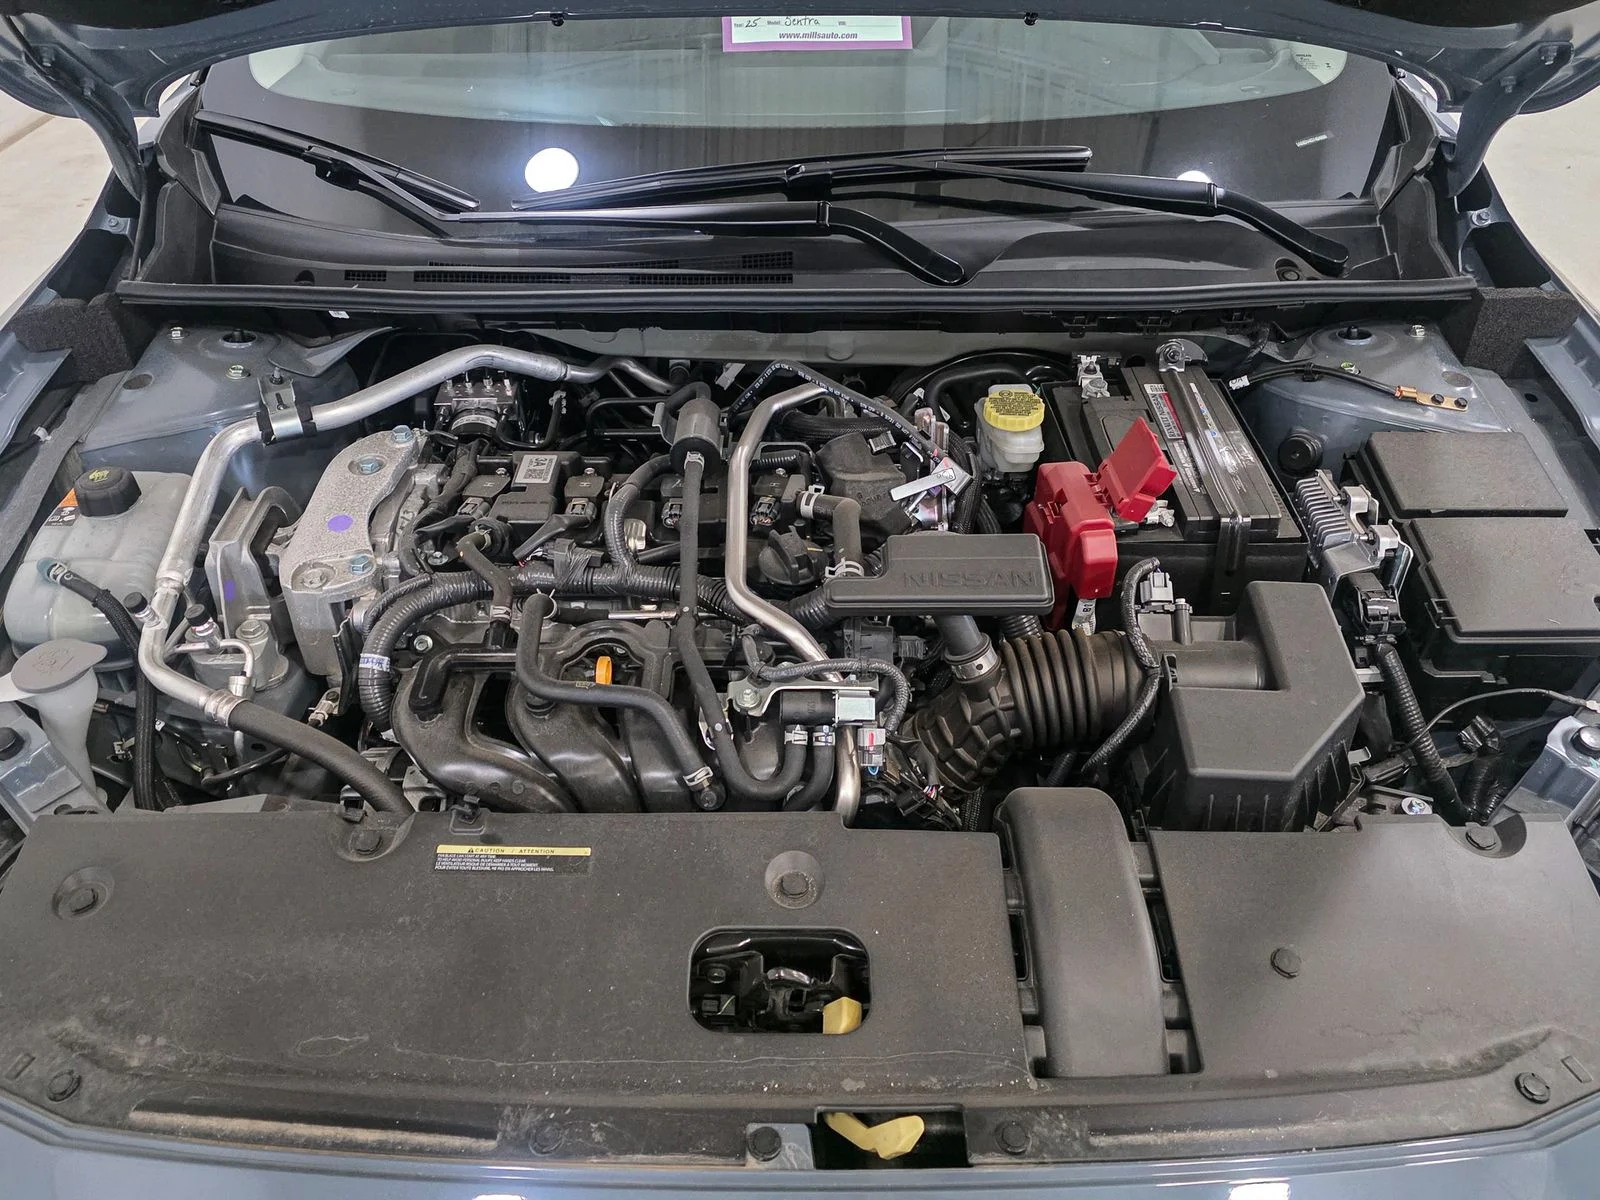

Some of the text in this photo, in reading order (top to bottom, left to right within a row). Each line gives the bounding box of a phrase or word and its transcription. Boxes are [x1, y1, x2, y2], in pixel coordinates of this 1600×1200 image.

[745, 17, 761, 28] 25
[778, 31, 858, 39] www.millsauto.com
[903, 569, 1038, 588] NISSAN
